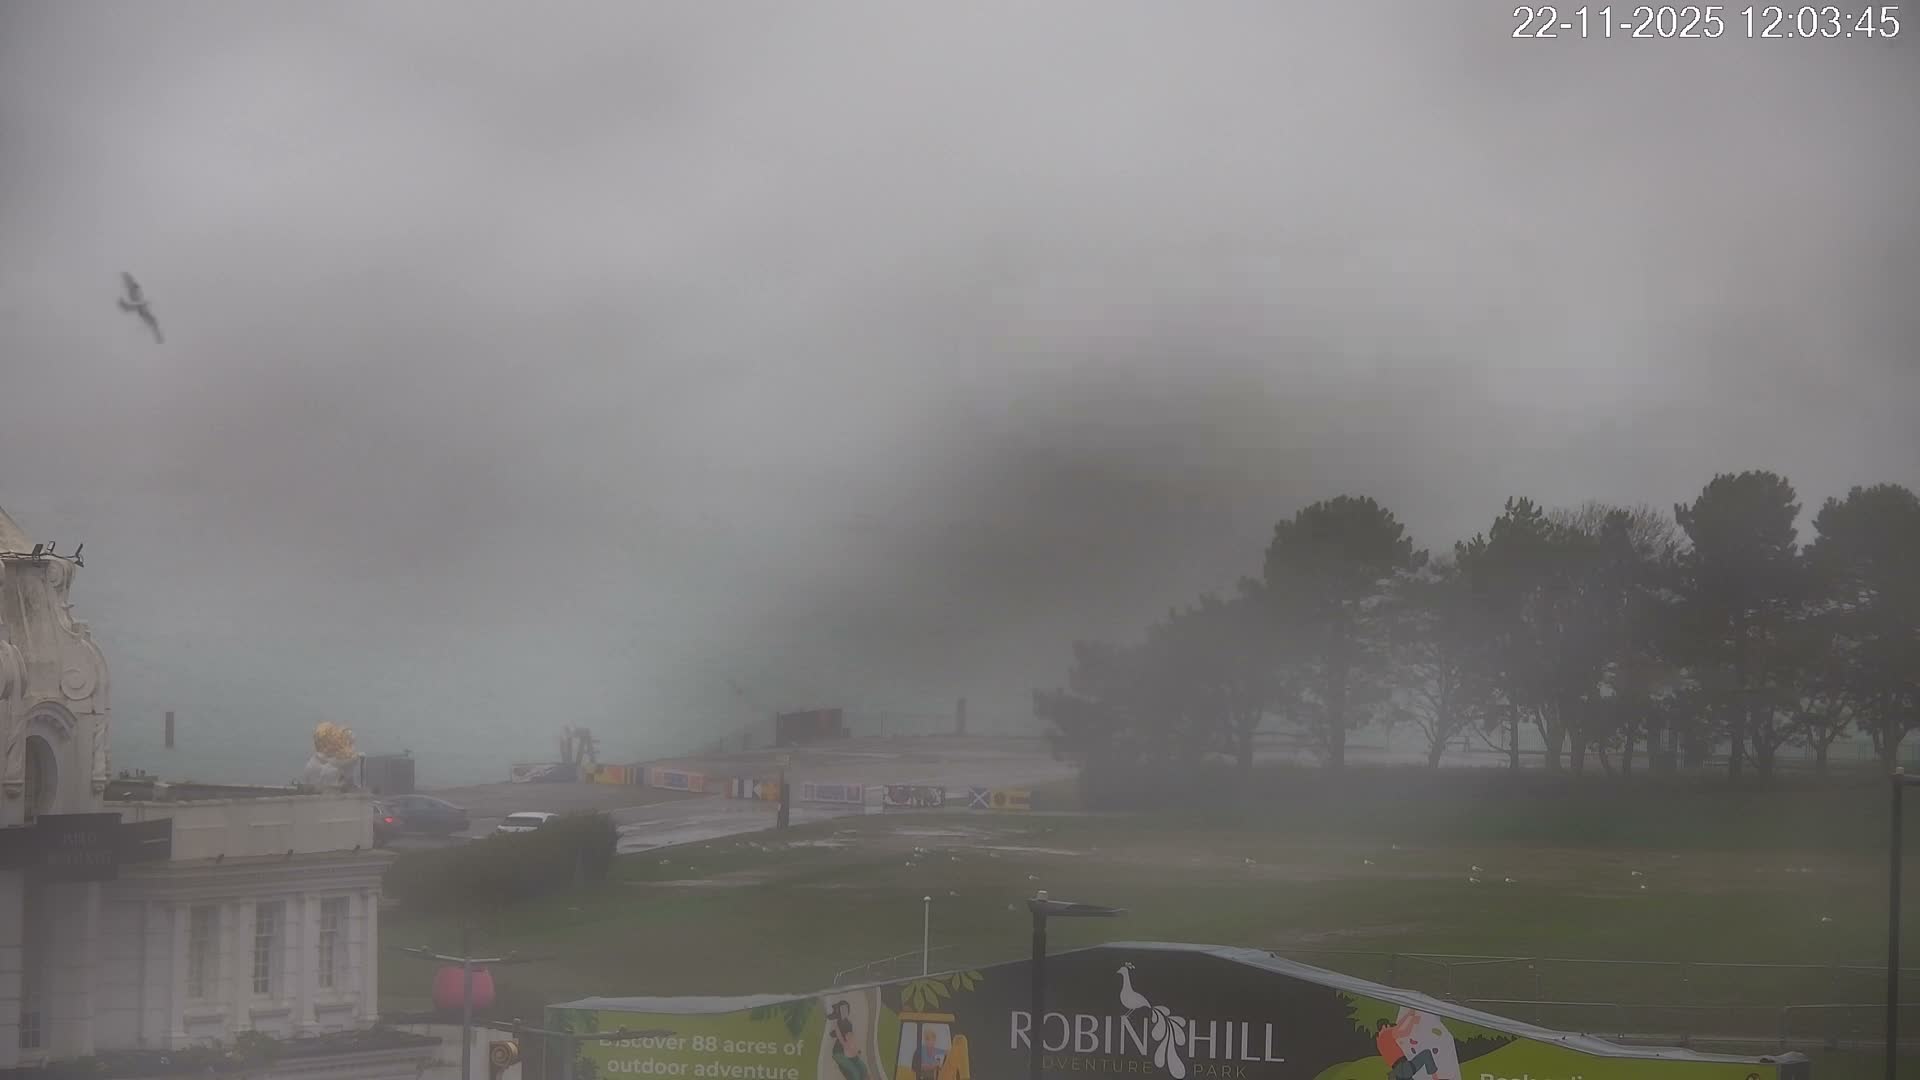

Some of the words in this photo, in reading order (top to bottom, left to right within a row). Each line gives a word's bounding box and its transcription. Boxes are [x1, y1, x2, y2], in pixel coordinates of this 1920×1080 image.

[692, 1035, 718, 1052] 88
[724, 1041, 777, 1056] acres
[783, 1039, 804, 1057] of
[1011, 1011, 1148, 1056] ROBIN
[1188, 1019, 1285, 1063] HILL
[607, 1057, 689, 1076] outdoor
[693, 1061, 799, 1080] adventure
[1024, 1055, 1152, 1074] DVENTURE
[1194, 1063, 1248, 1080] PARK
